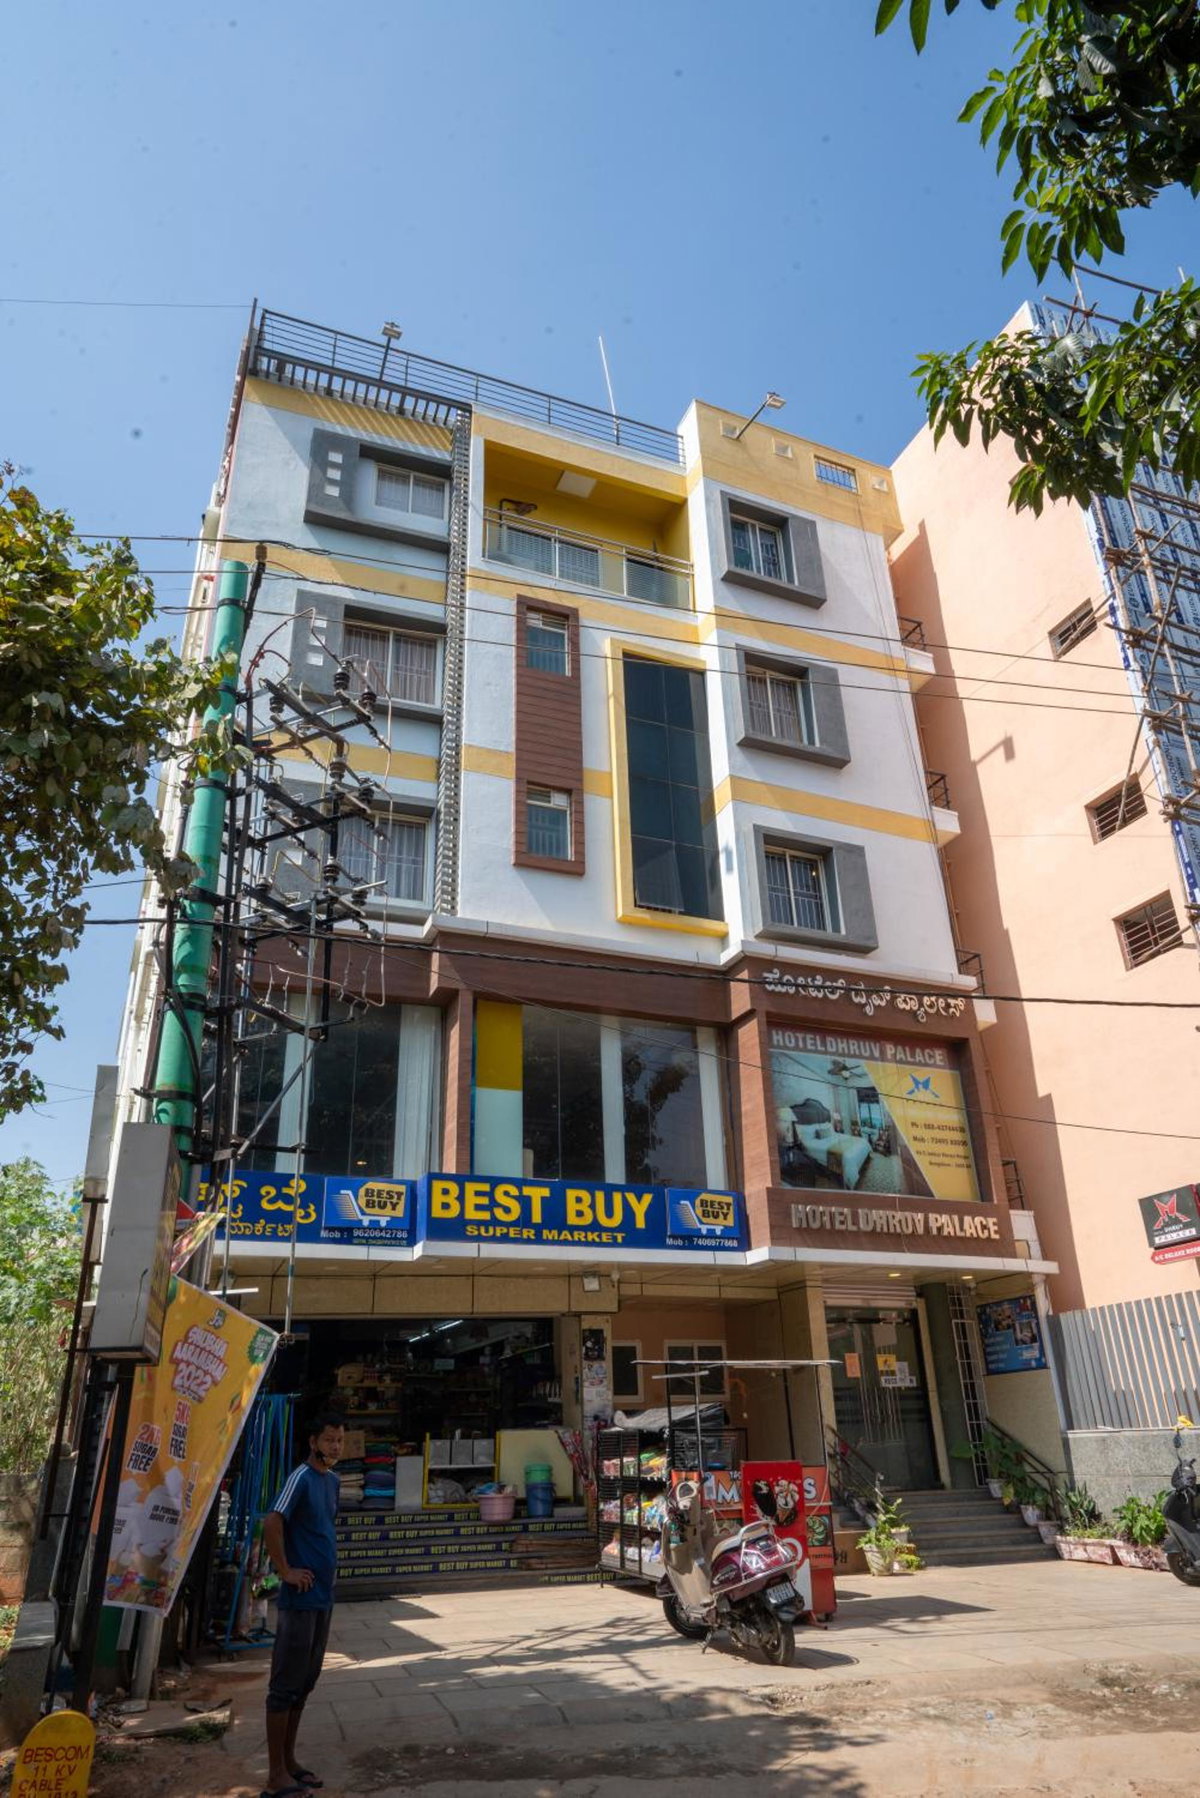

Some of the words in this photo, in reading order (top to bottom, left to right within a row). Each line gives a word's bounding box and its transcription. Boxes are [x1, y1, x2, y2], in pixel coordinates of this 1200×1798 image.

[886, 1044, 946, 1066] PALACE
[364, 1188, 404, 1200] BEST
[365, 1199, 400, 1211] BUY
[431, 1179, 550, 1223] BEST
[566, 1188, 653, 1229] BUY
[700, 1198, 733, 1210] BEST
[702, 1209, 731, 1221] BUY
[791, 1203, 857, 1231] HOTEL
[858, 1208, 924, 1235] DHRUV
[929, 1213, 1000, 1240] PALACE
[465, 1225, 536, 1239] SUPER
[542, 1229, 626, 1244] MARKET
[173, 1361, 213, 1398] 2022
[133, 1440, 158, 1458] SUGAR
[127, 1453, 153, 1472] FREE
[460, 1526, 475, 1535] BEST
[476, 1526, 487, 1534] BUY
[528, 1524, 543, 1532] BEST
[543, 1523, 556, 1531] BUY
[431, 1546, 446, 1554] BEST
[447, 1544, 459, 1553] BUY
[439, 1562, 455, 1570] BEST
[456, 1561, 469, 1570] BUY
[22, 1745, 90, 1764] BESCOM
[34, 1764, 48, 1777] 11
[18, 1778, 66, 1792] CABLE
